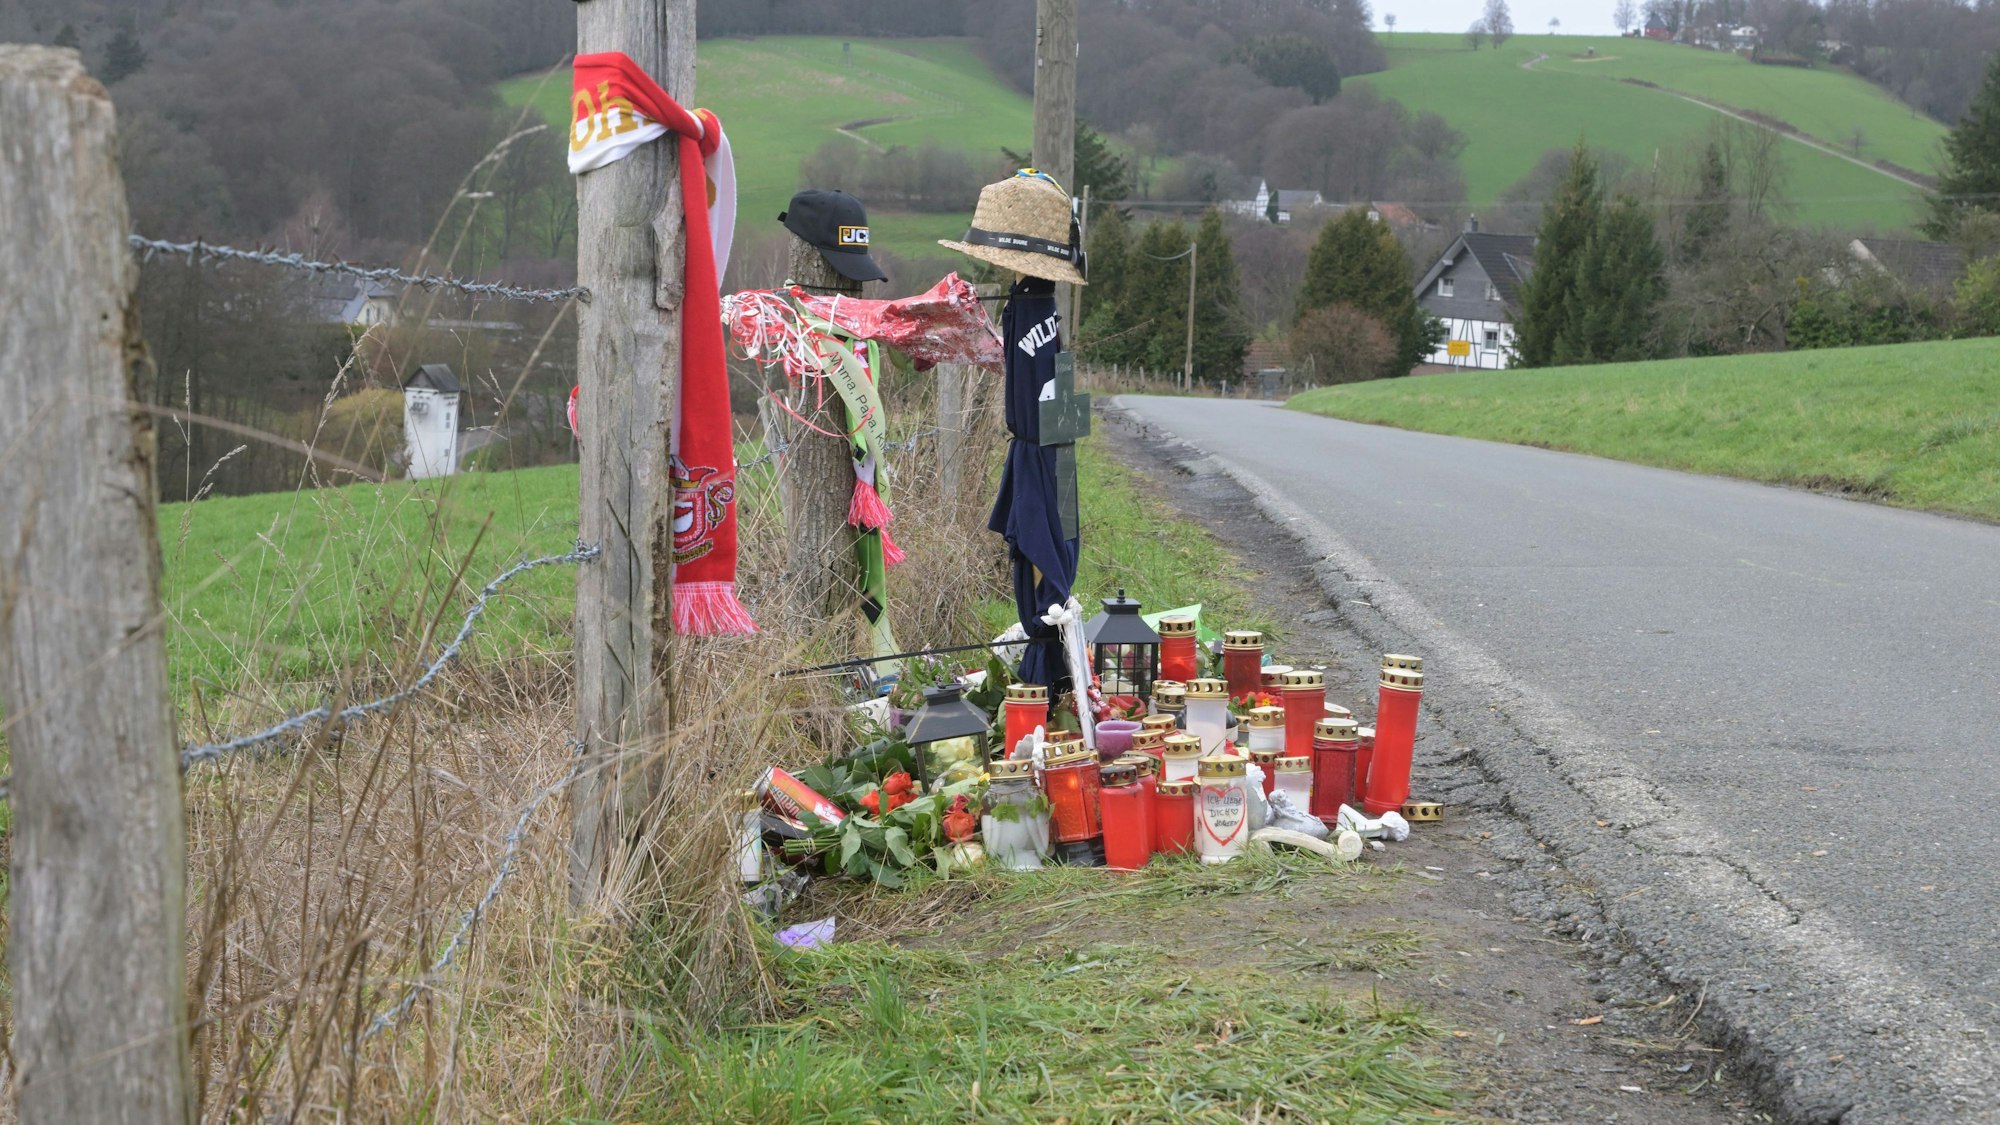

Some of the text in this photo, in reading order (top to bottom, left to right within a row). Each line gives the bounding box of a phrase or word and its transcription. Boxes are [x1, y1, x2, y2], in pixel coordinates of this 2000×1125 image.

[1018, 310, 1058, 357] WILD
[1207, 795, 1221, 805] ICH
[1209, 808, 1230, 818] DICH
